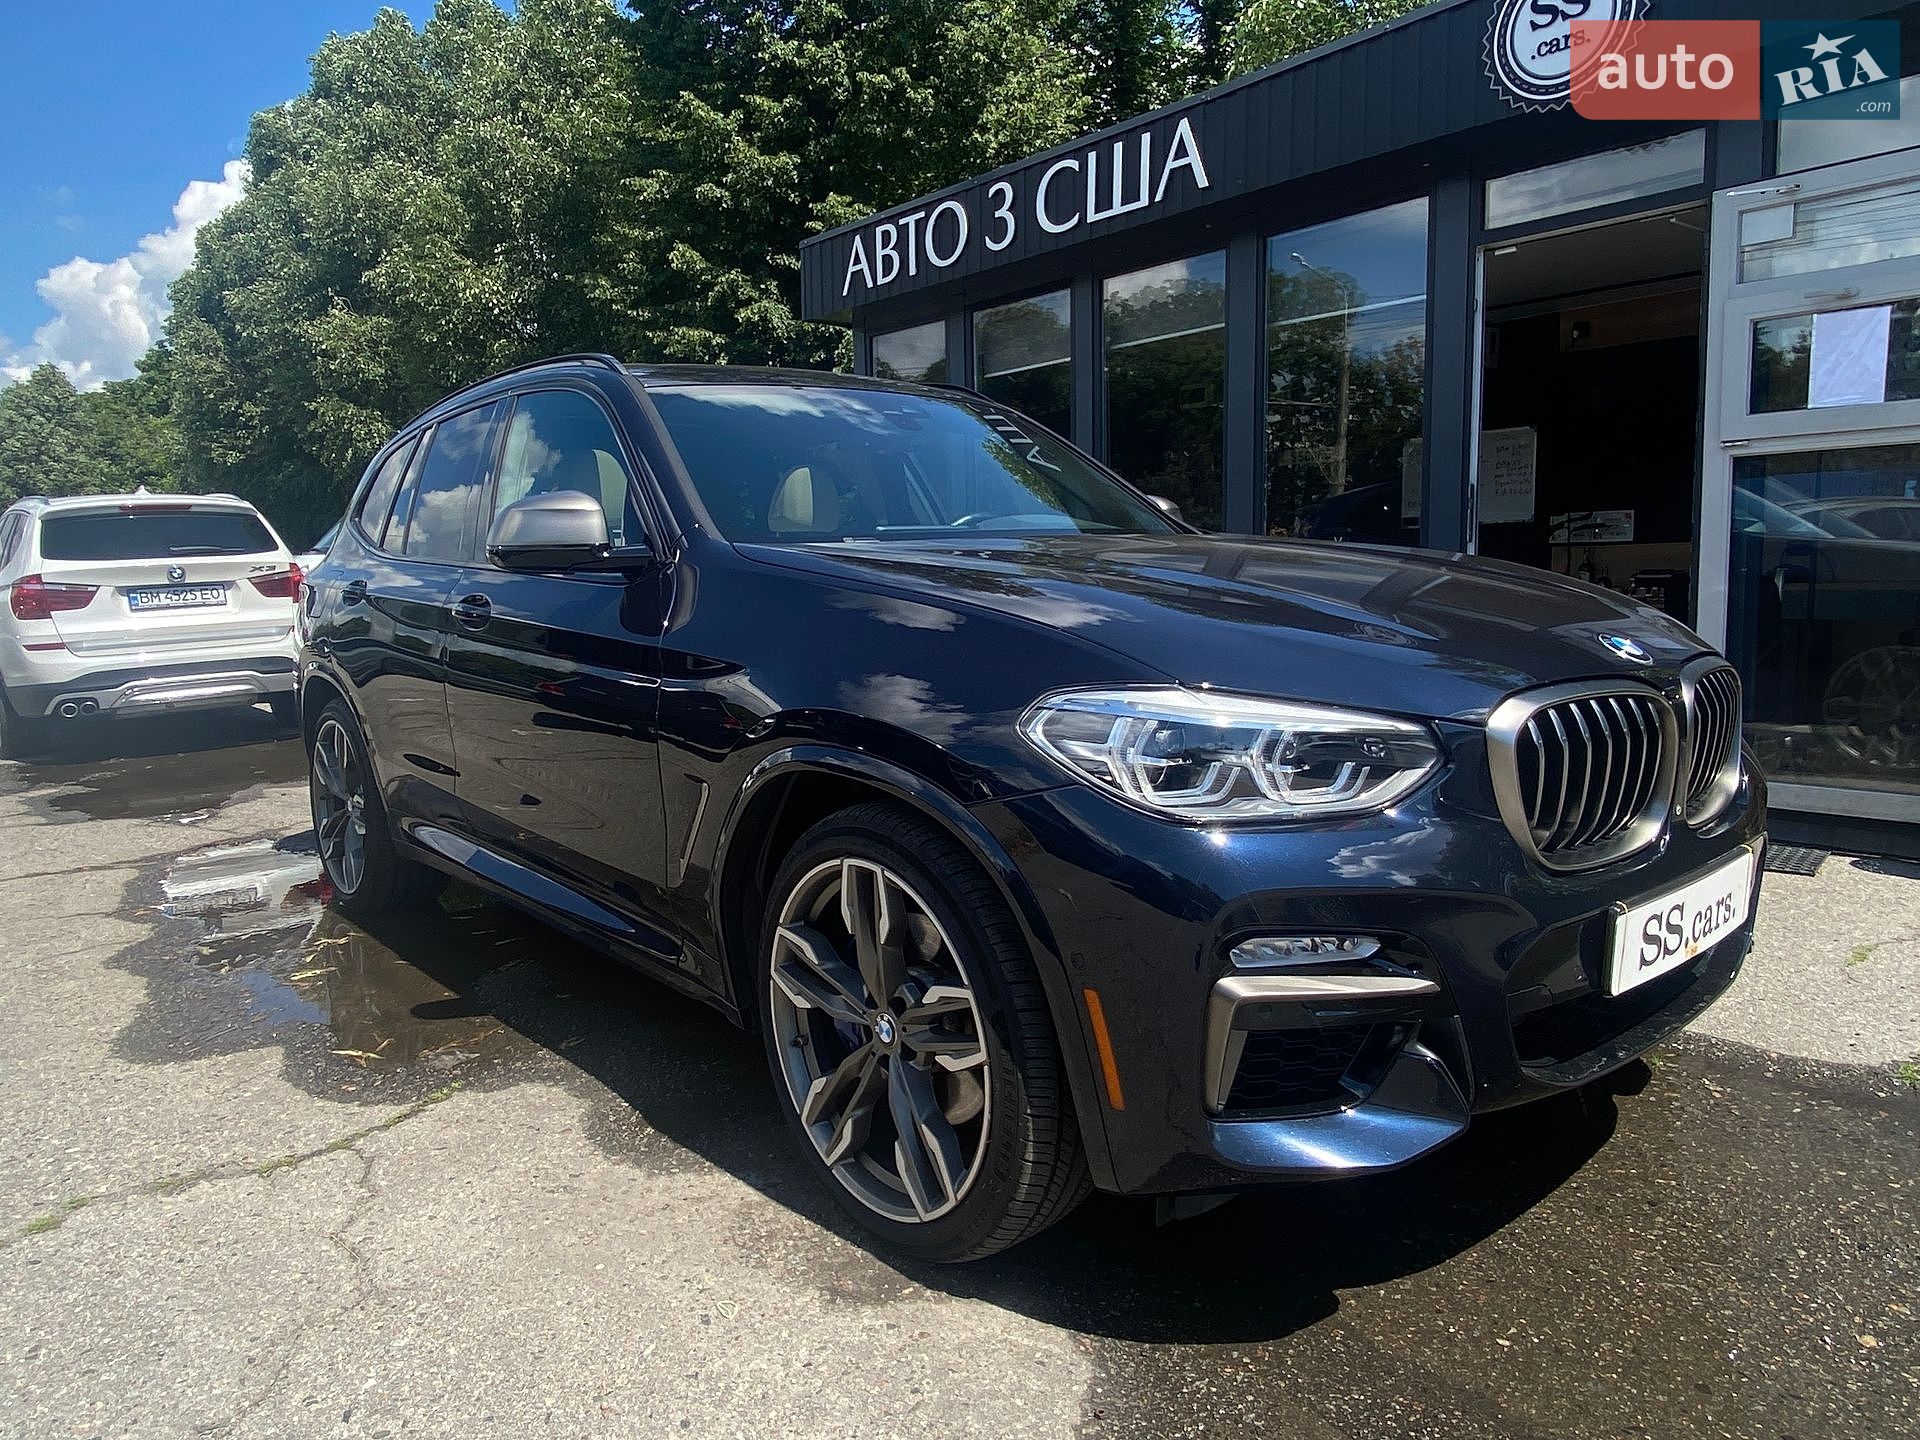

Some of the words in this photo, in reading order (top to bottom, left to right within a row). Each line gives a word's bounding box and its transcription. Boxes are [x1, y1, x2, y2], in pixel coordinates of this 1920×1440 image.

[841, 200, 968, 297] АВТО
[1035, 116, 1209, 234] США
[247, 565, 277, 573] X3
[139, 591, 162, 604] BM
[164, 589, 198, 602] 4525
